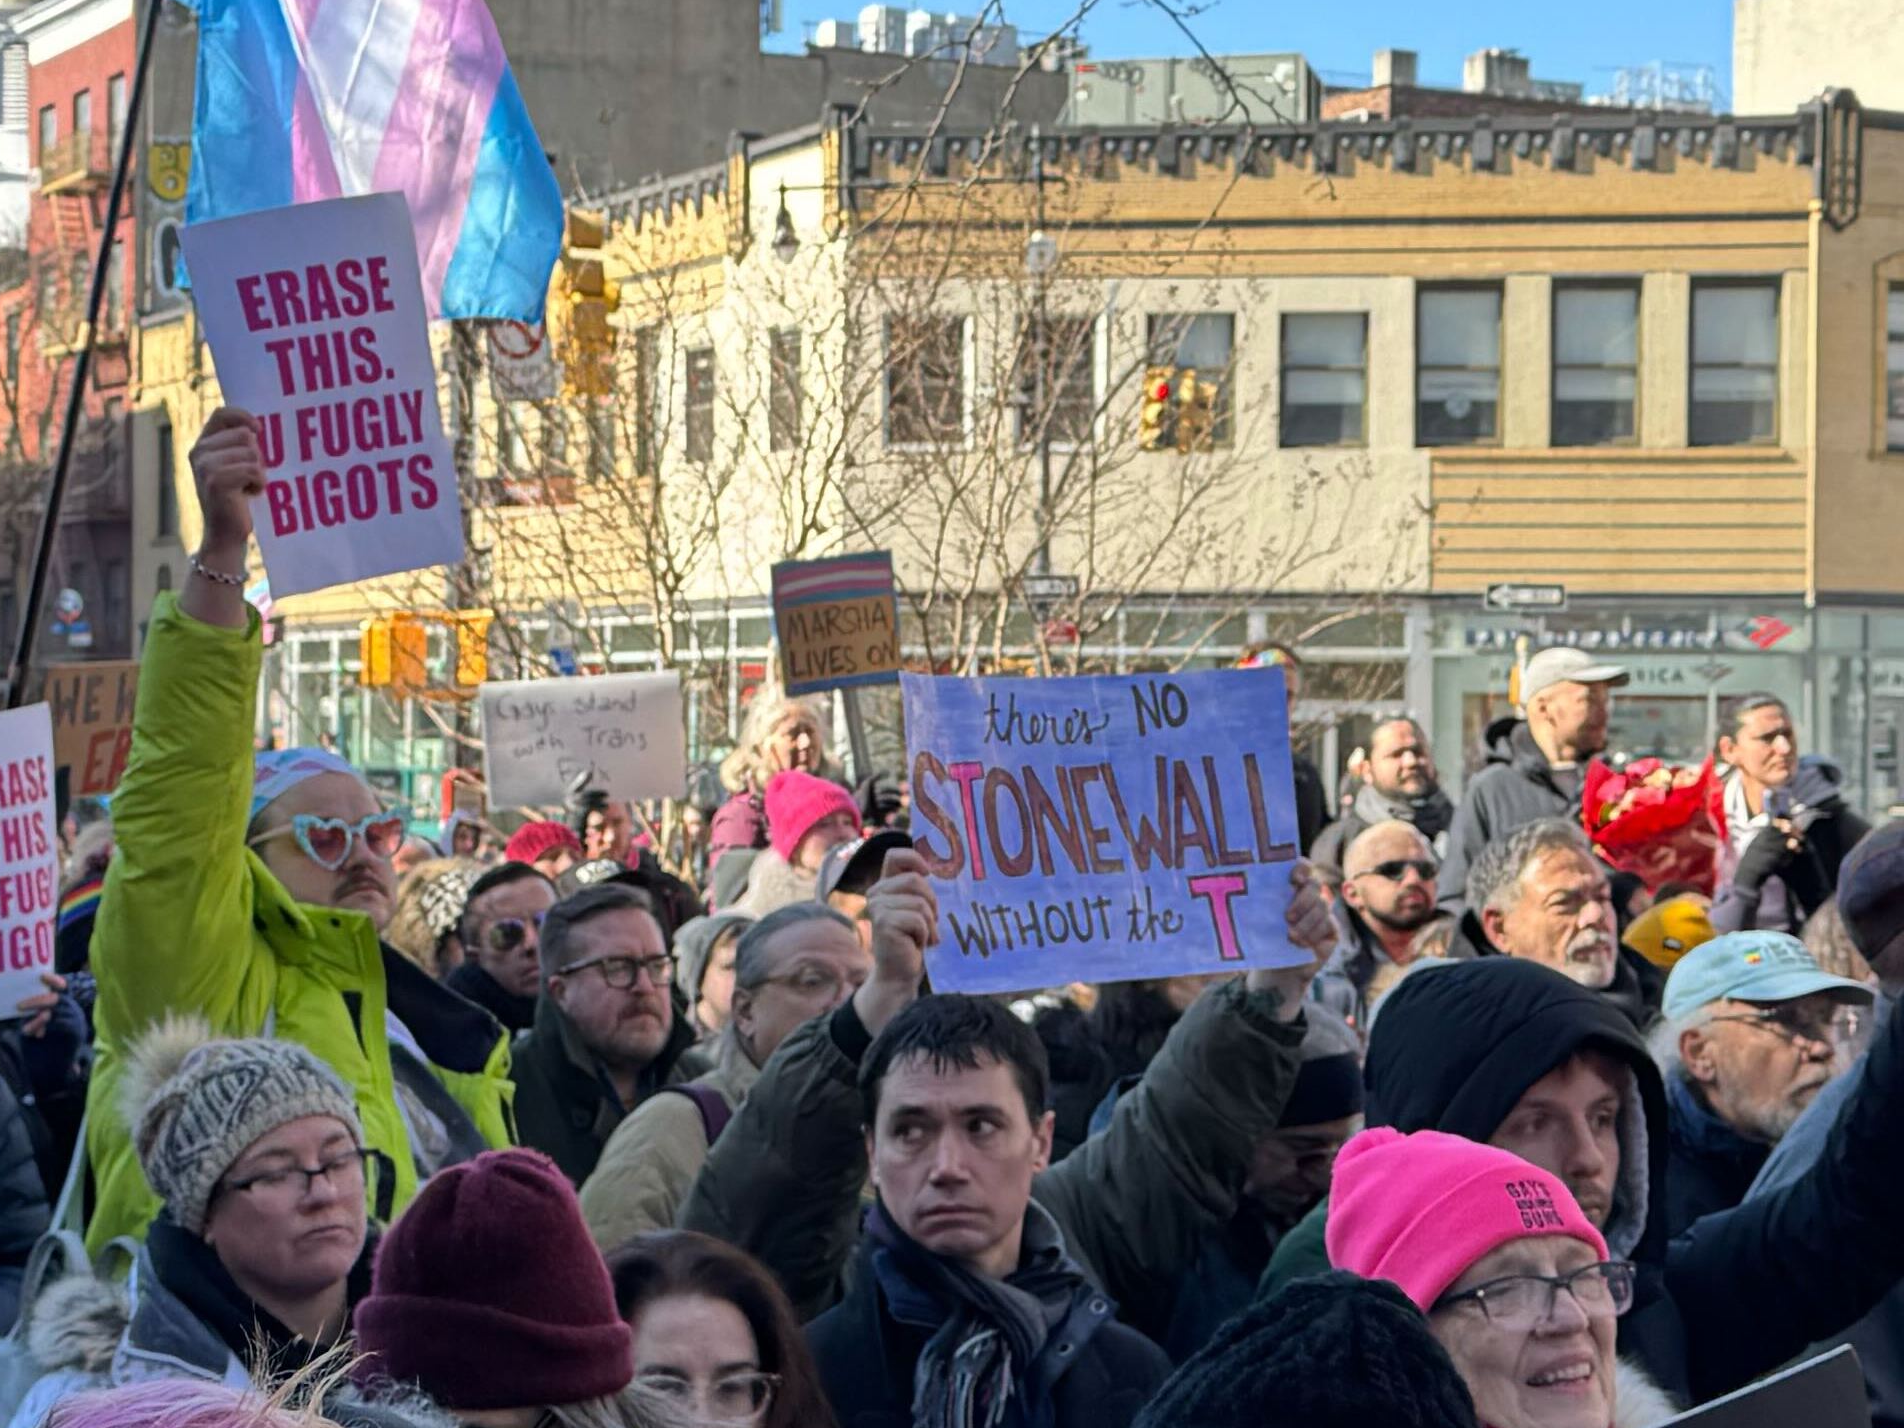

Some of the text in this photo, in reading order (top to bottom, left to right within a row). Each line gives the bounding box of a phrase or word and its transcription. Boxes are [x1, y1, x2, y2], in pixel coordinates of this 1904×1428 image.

[236, 256, 394, 332] ERASE
[265, 327, 394, 396] THIS.
[257, 390, 424, 469] U FUGLY
[265, 454, 438, 537] BIGOTS
[787, 601, 889, 645] MARSHA
[789, 632, 896, 678] LIVES ON
[983, 680, 1189, 746] there's NO
[912, 750, 1297, 881] STONEWALL
[0, 863, 55, 920] FUG
[947, 872, 1249, 962] WITHOUT the T
